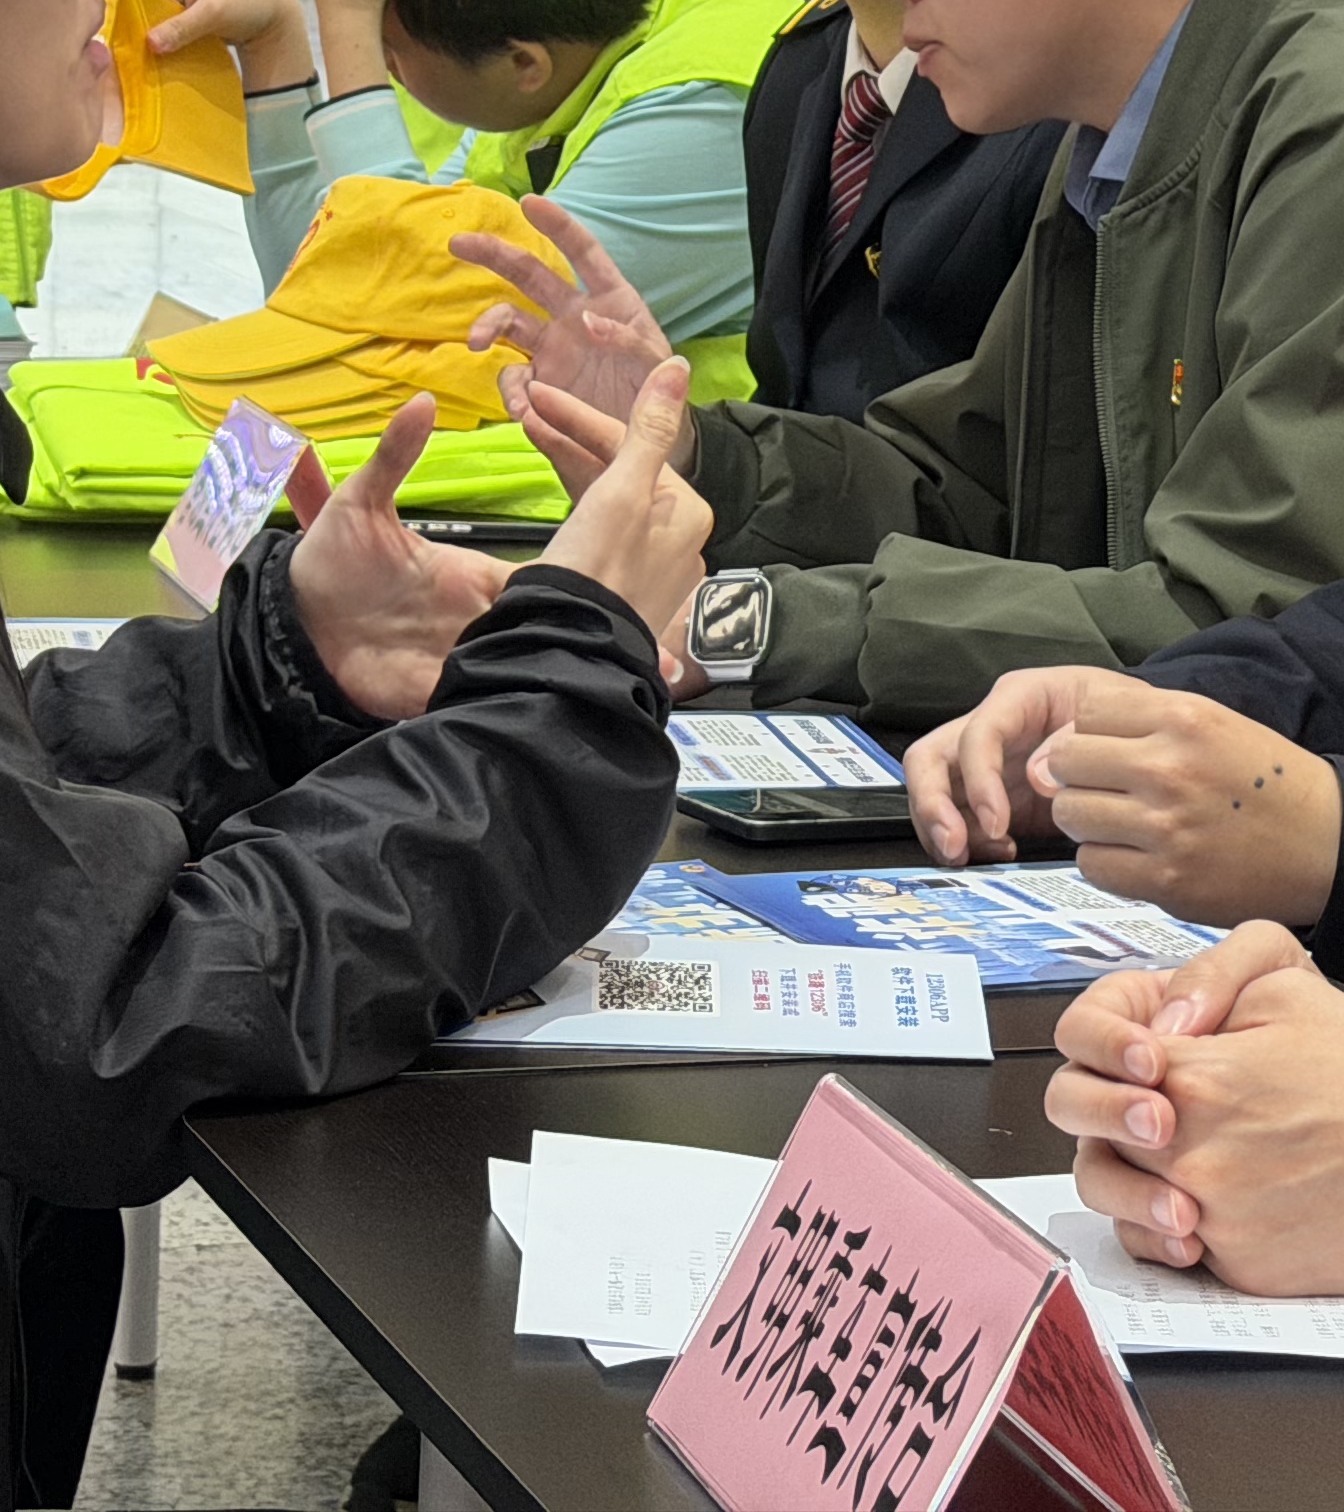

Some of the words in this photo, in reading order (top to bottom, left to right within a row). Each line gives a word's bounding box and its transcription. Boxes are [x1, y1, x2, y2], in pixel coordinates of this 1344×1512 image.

[891, 966, 920, 1027] 软件下载安装
[926, 973, 950, 1023] 12306APP
